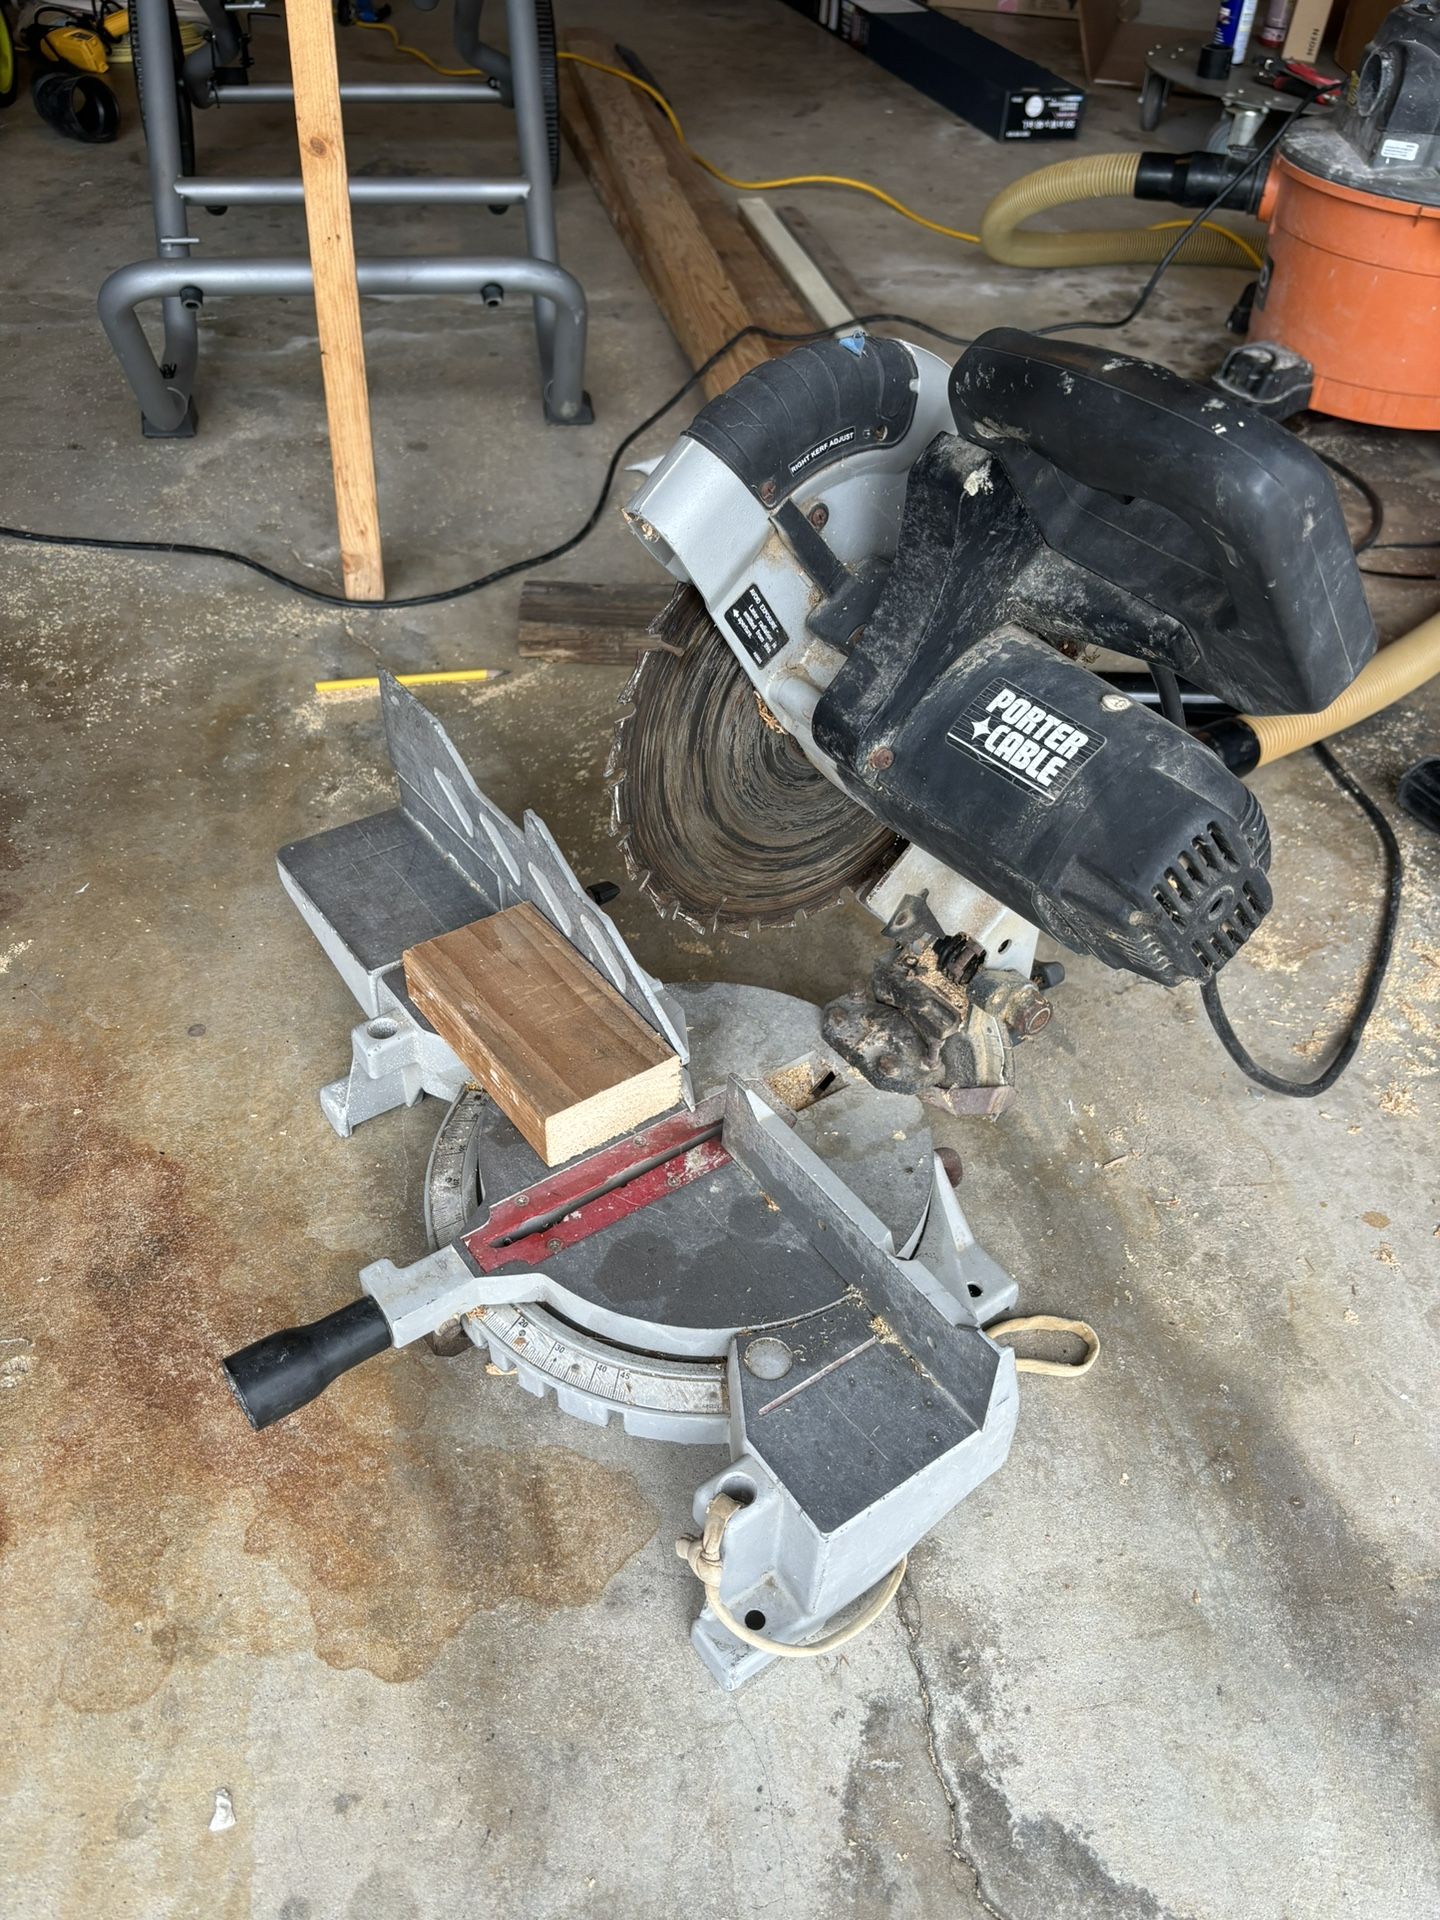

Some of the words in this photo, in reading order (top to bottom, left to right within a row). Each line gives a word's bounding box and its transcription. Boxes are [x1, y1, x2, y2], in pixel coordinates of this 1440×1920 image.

[791, 454, 810, 473] RIGHT
[810, 443, 829, 458] KERF
[829, 432, 854, 447] ADJUST
[749, 588, 761, 605] AVOID
[759, 603, 778, 630] EXPOSURE
[985, 688, 1089, 760] PORTER
[984, 724, 1068, 787] CABLE
[518, 1319, 529, 1328] 20
[554, 1344, 566, 1353] 30
[597, 1365, 608, 1373] 40
[620, 1371, 630, 1380] 45
